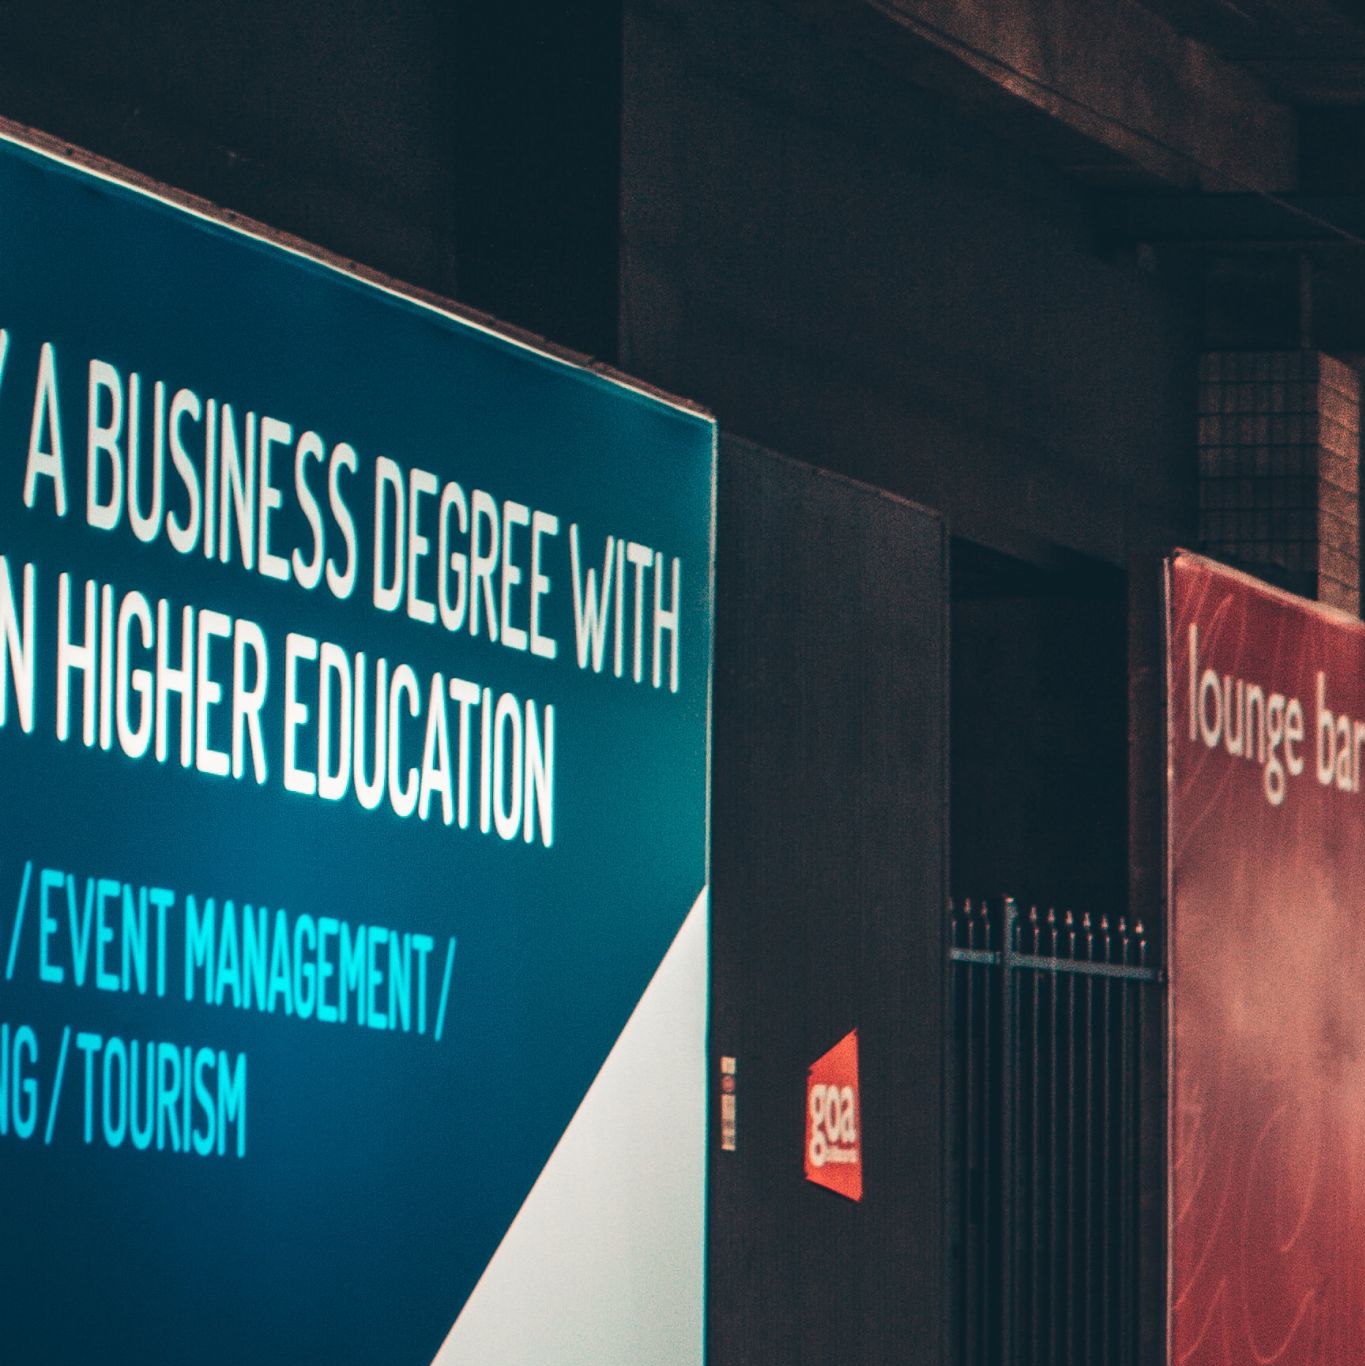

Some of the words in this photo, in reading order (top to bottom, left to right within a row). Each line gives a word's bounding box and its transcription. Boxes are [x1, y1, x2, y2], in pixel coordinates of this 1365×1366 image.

[23, 341, 67, 517] A
[86, 358, 358, 600] BUSINESS
[374, 455, 559, 660] DEGREE
[569, 522, 681, 694] WITH
[56, 571, 268, 786] HIGHER
[283, 631, 555, 849] EDUCATION
[1188, 621, 1304, 806] lounge
